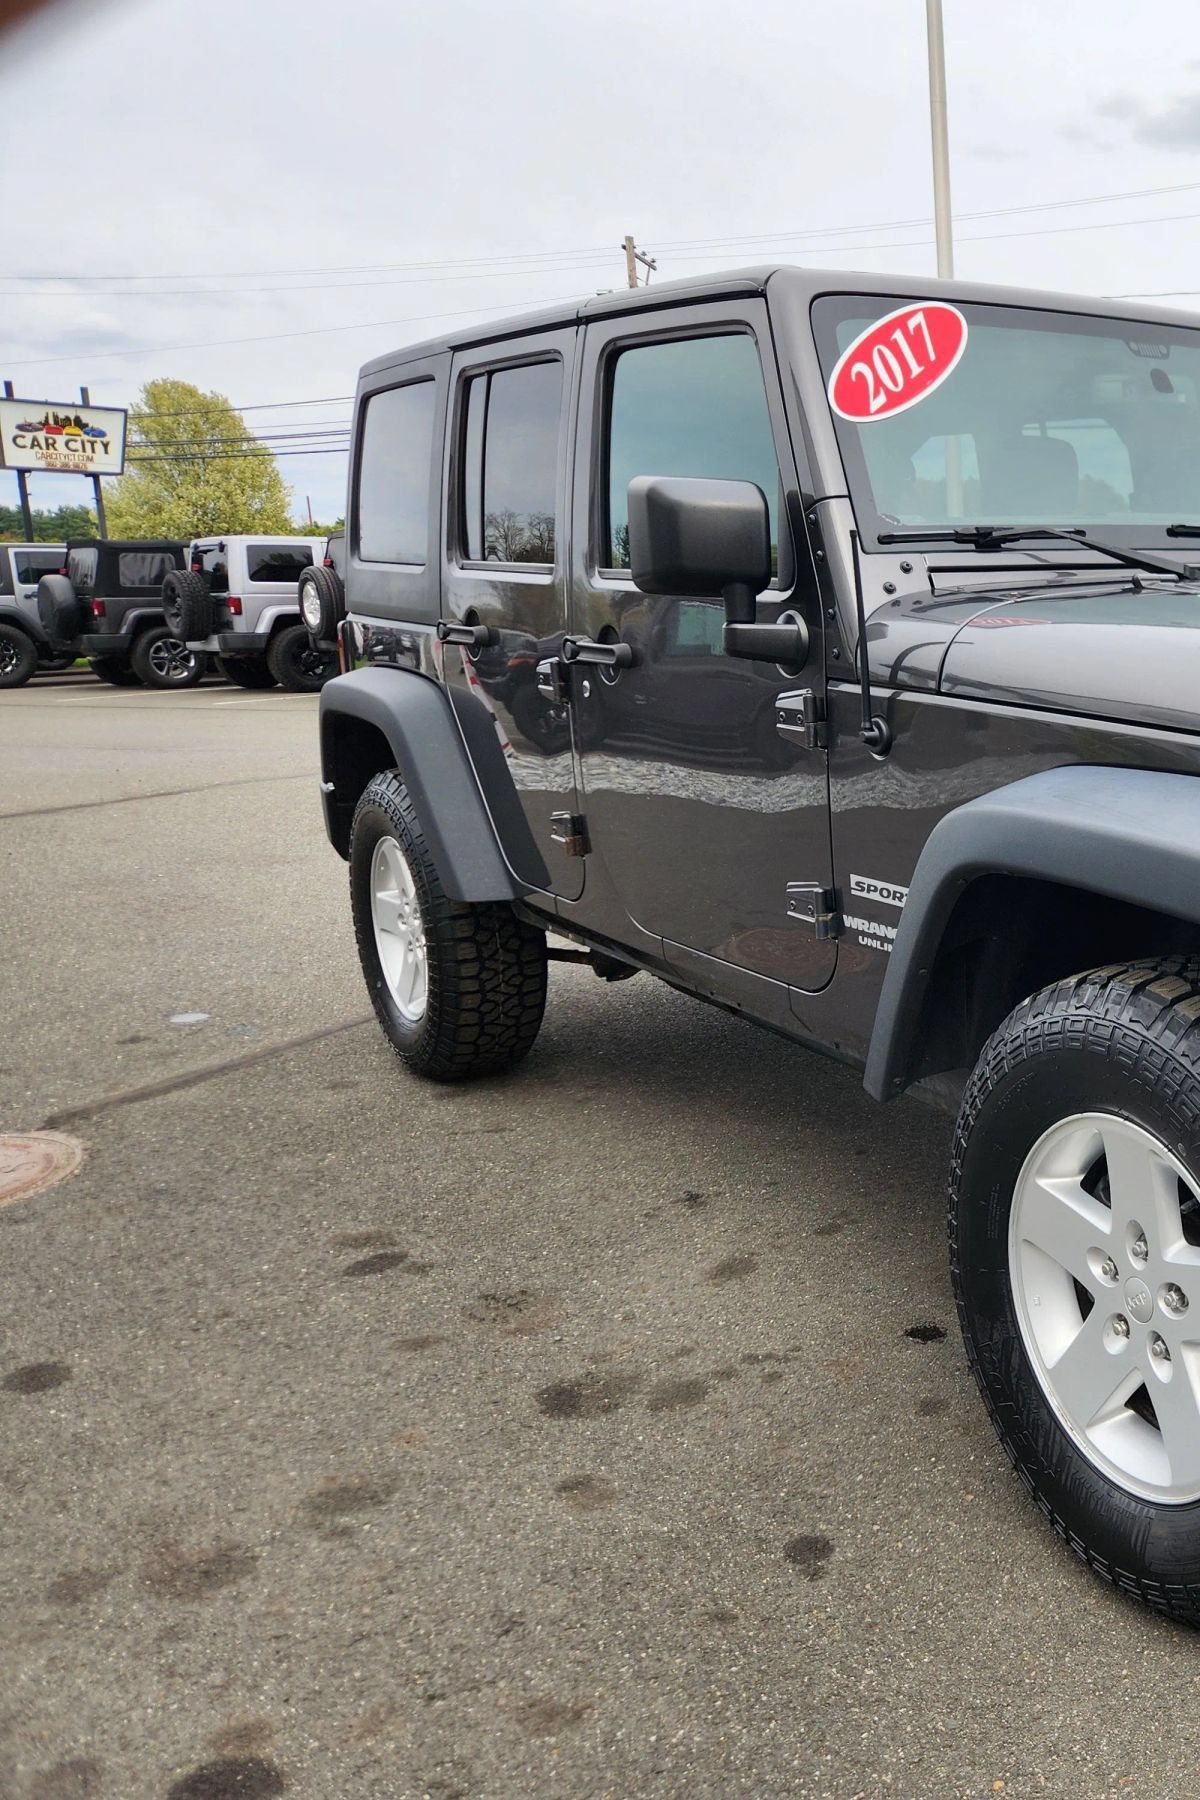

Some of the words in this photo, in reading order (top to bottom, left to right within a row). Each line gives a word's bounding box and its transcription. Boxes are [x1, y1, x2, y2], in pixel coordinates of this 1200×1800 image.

[850, 310, 936, 414] 2017
[12, 433, 58, 452] CAR
[64, 437, 110, 455] CITY
[851, 880, 908, 903] SPOR
